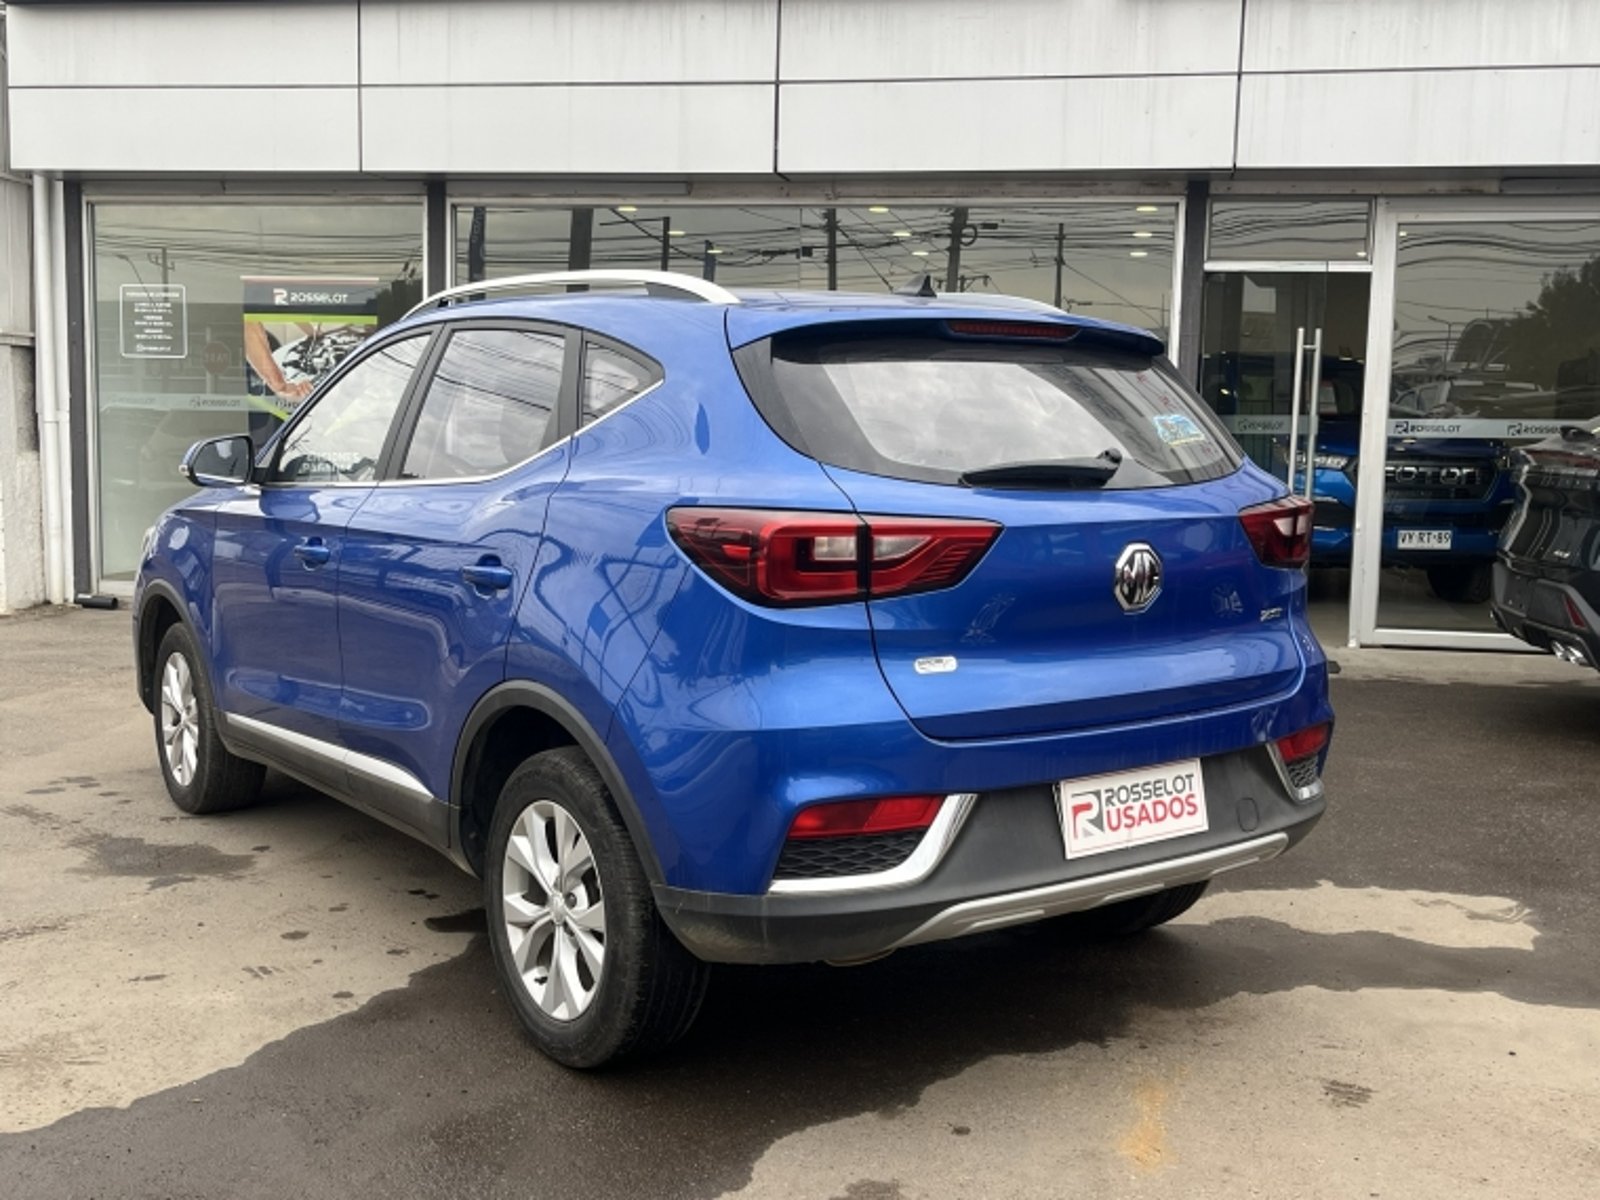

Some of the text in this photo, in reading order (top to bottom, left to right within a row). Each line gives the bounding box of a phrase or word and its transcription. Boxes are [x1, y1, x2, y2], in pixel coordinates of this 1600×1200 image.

[290, 292, 348, 303] ROSSELOT
[1104, 773, 1195, 807] ROSSELOT
[1106, 793, 1198, 831] USADOS
